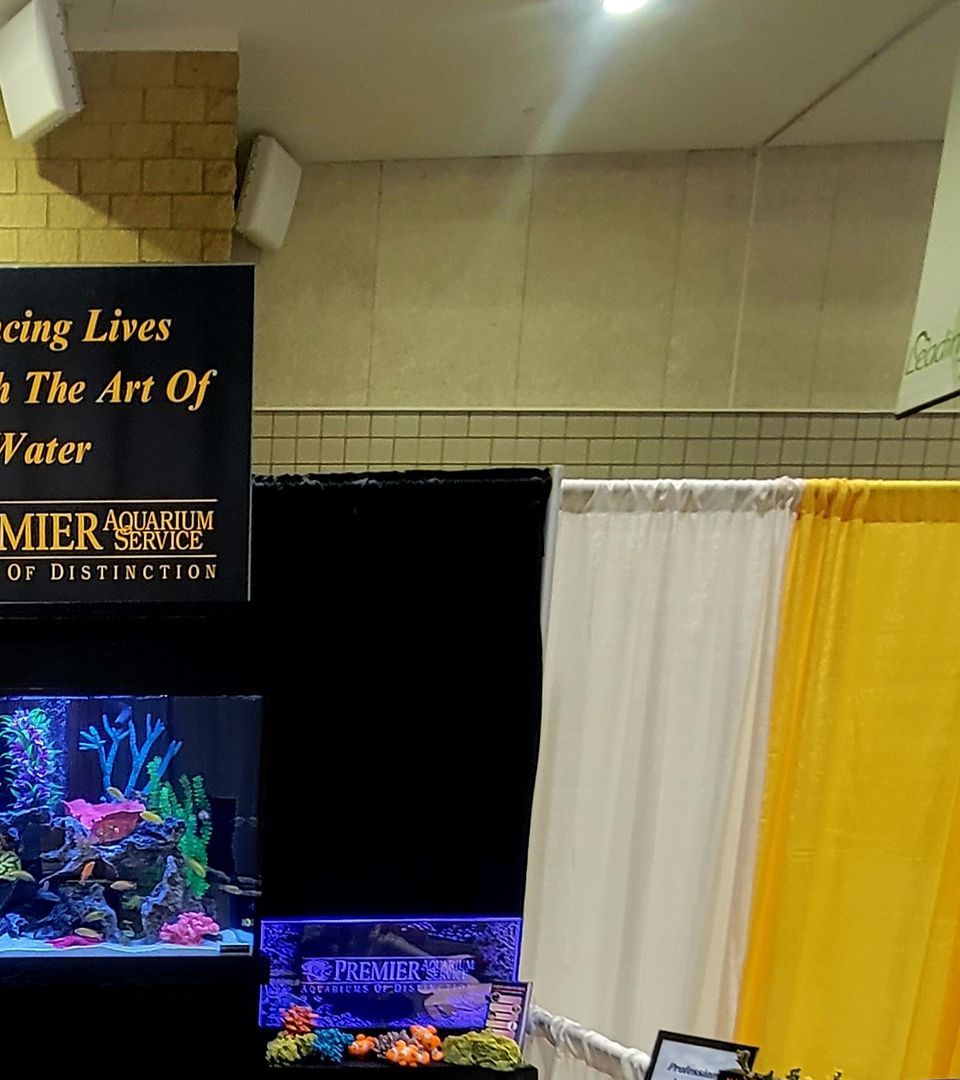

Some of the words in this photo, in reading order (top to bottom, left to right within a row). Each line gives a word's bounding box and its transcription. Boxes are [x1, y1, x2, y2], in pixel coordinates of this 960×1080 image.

[82, 309, 172, 342] Lives
[23, 370, 84, 404] The
[95, 370, 154, 403] Art
[166, 369, 218, 410] Of
[103, 510, 213, 533] AQUARIUM
[113, 530, 203, 551] SERVICE
[8, 564, 36, 581] OF
[51, 563, 217, 581] DISTINCTION
[334, 960, 420, 981] PREMIER
[301, 984, 368, 995] AQUARIUMS
